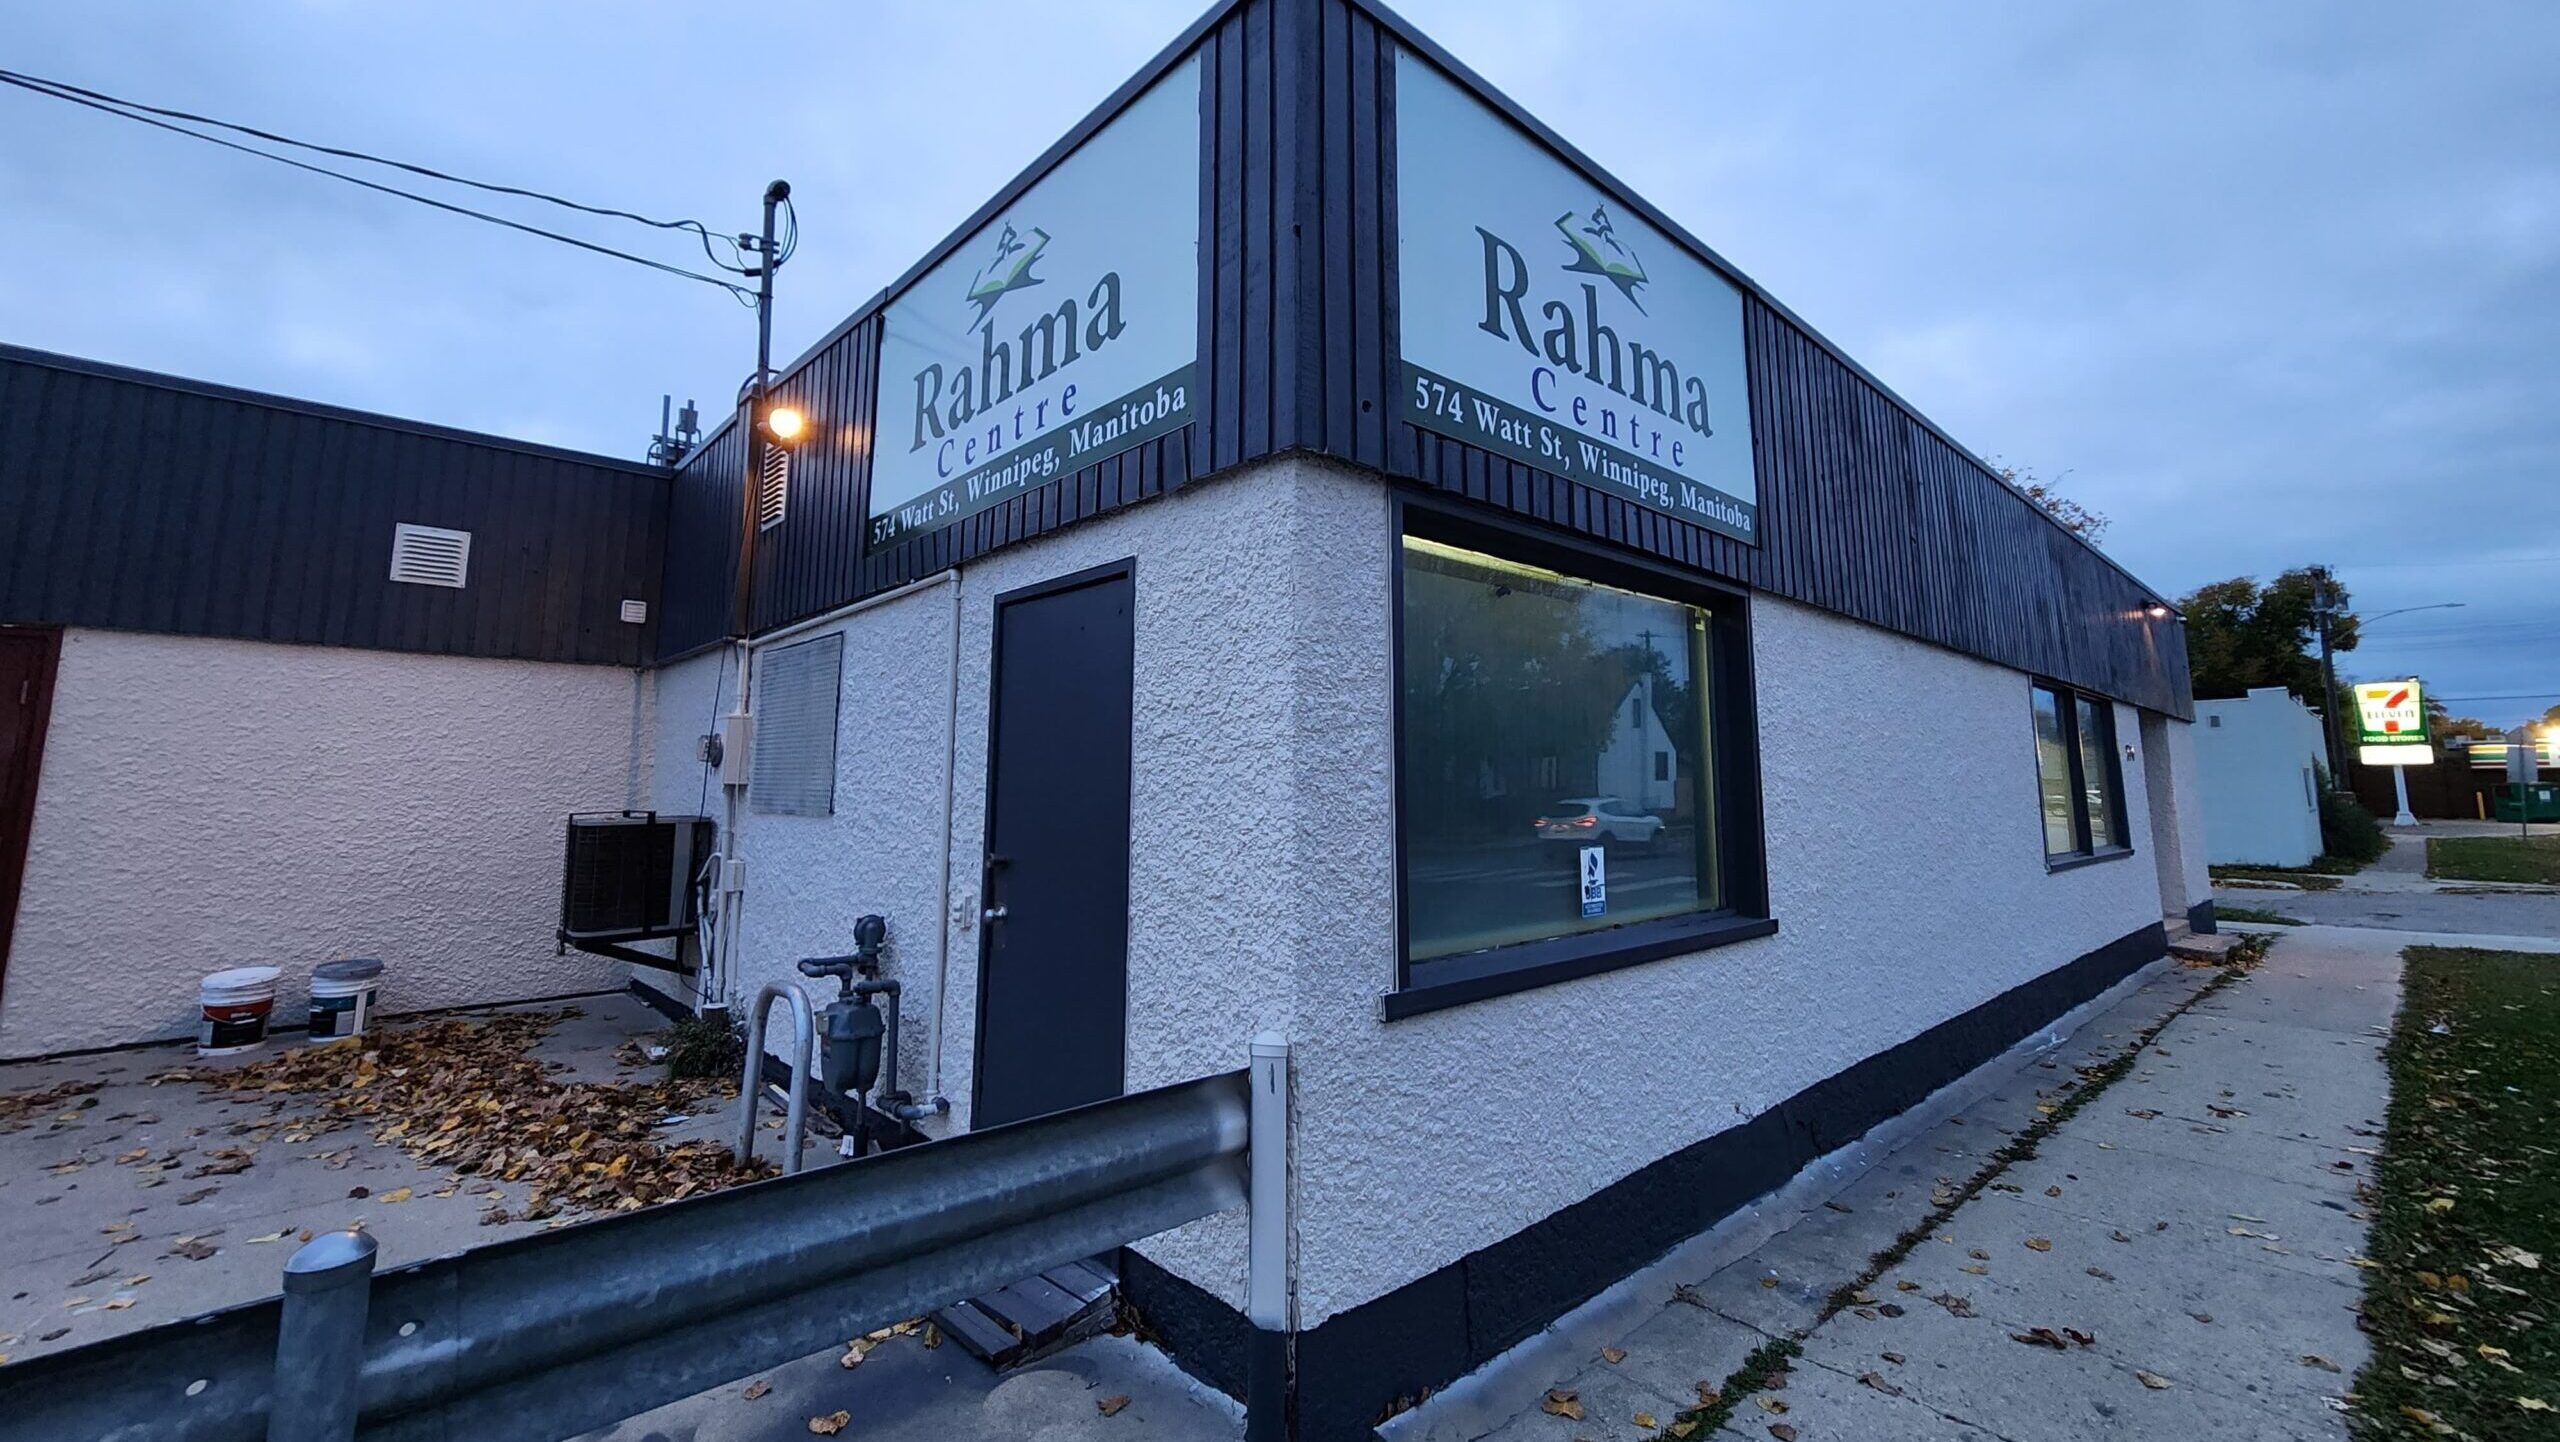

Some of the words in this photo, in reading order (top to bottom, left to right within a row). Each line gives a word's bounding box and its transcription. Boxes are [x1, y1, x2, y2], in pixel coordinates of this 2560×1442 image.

[909, 271, 1126, 453] Rahma
[1475, 225, 1713, 438] Rahma
[873, 520, 896, 545] 574
[900, 501, 934, 532] Watt
[938, 489, 960, 515] St,
[966, 446, 1060, 503] Winnipeg,
[1068, 385, 1187, 458] Manitoba
[937, 384, 1077, 478] Centre
[1415, 376, 1464, 424] 574
[1472, 397, 1532, 449] Watt
[1540, 426, 1570, 471] St,
[1577, 440, 1675, 509] Winnipeg,
[1680, 481, 1751, 532] Manitoba
[1531, 367, 1684, 467] Centre
